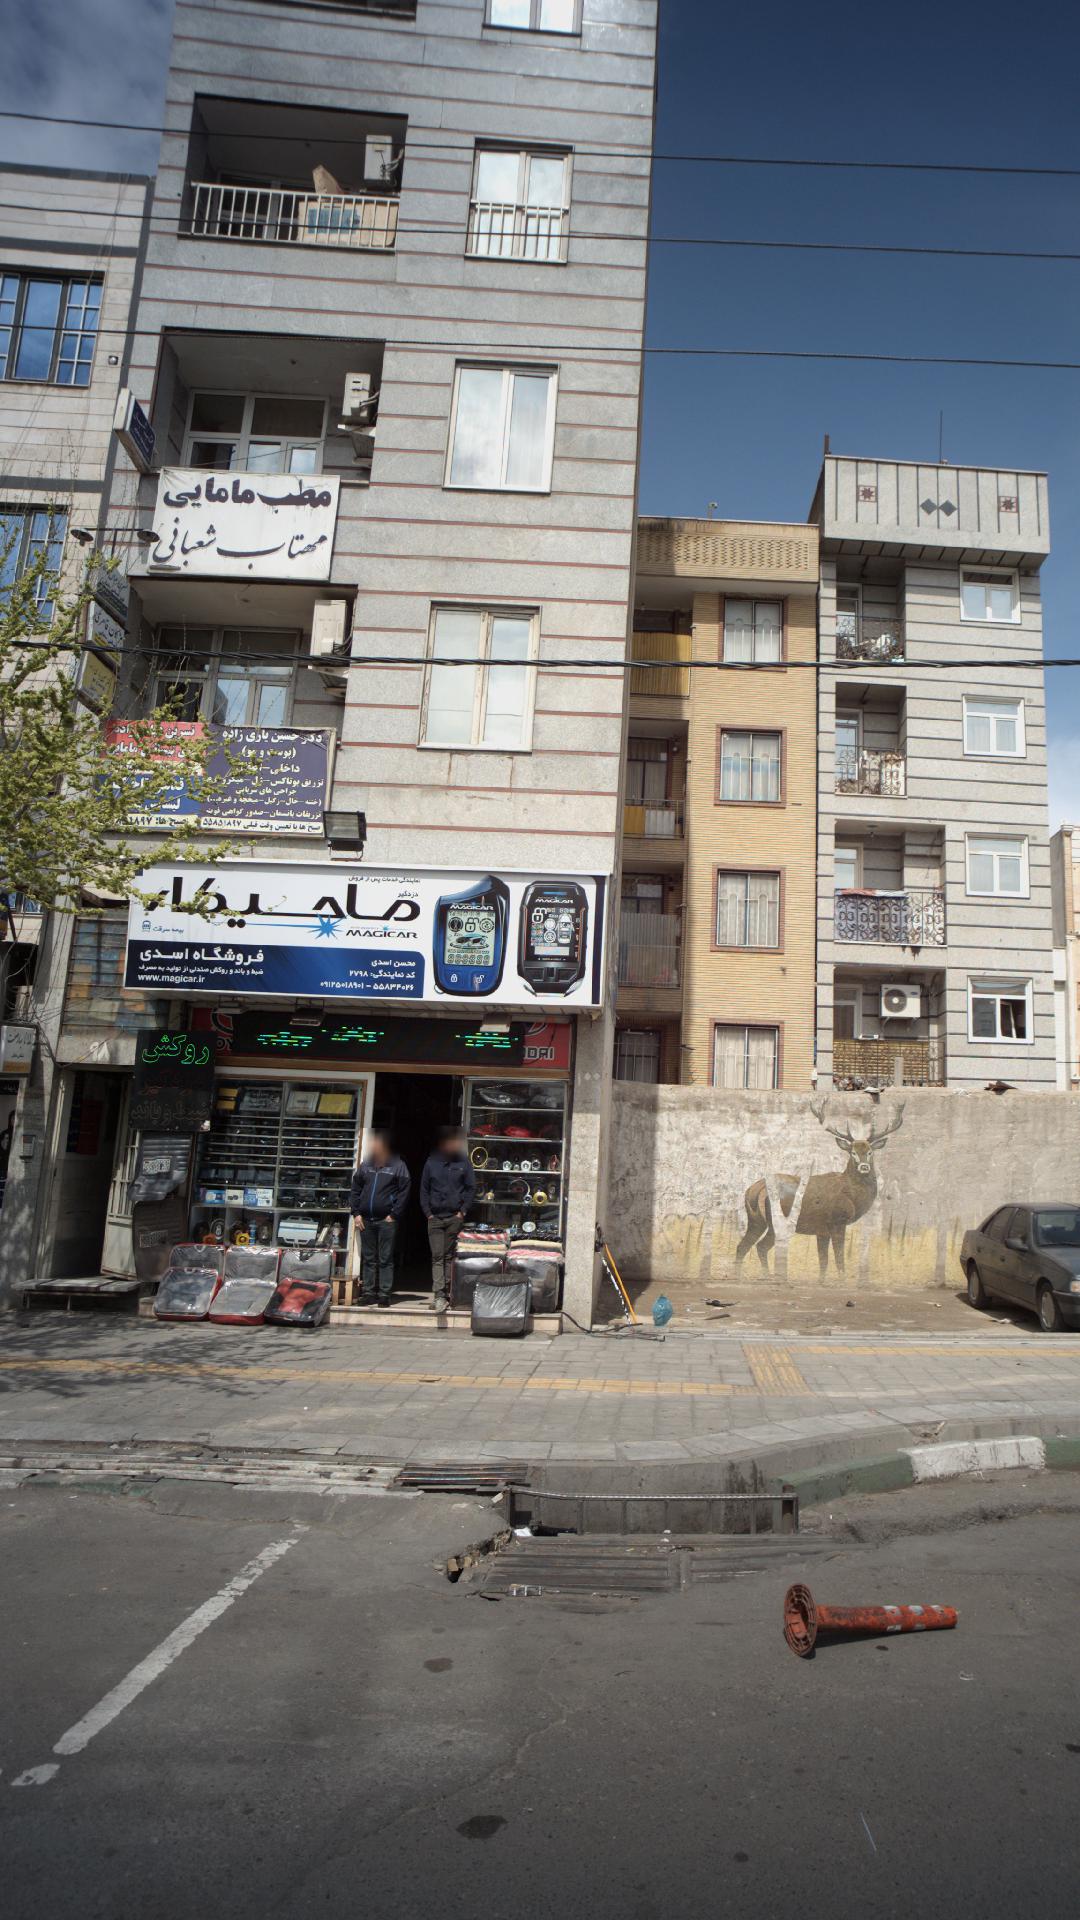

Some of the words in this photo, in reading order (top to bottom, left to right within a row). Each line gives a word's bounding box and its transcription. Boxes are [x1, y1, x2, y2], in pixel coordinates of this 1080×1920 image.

[163, 476, 256, 508] مامایی
[256, 479, 332, 514] مطب
[152, 516, 217, 567] شعبانی
[216, 533, 328, 570] مهتاب
[222, 729, 243, 743] زاده
[270, 732, 300, 743] حسین
[397, 890, 419, 898] دزدگیر
[346, 928, 419, 938] MAGICAR
[139, 947, 189, 962] اسدی
[192, 946, 265, 966] فروشگاه
[371, 959, 393, 967] اسدی
[393, 960, 416, 968] محسن
[137, 974, 206, 984] www.magicar.ir
[405, 971, 416, 979] کد
[141, 1034, 210, 1065] روکش
